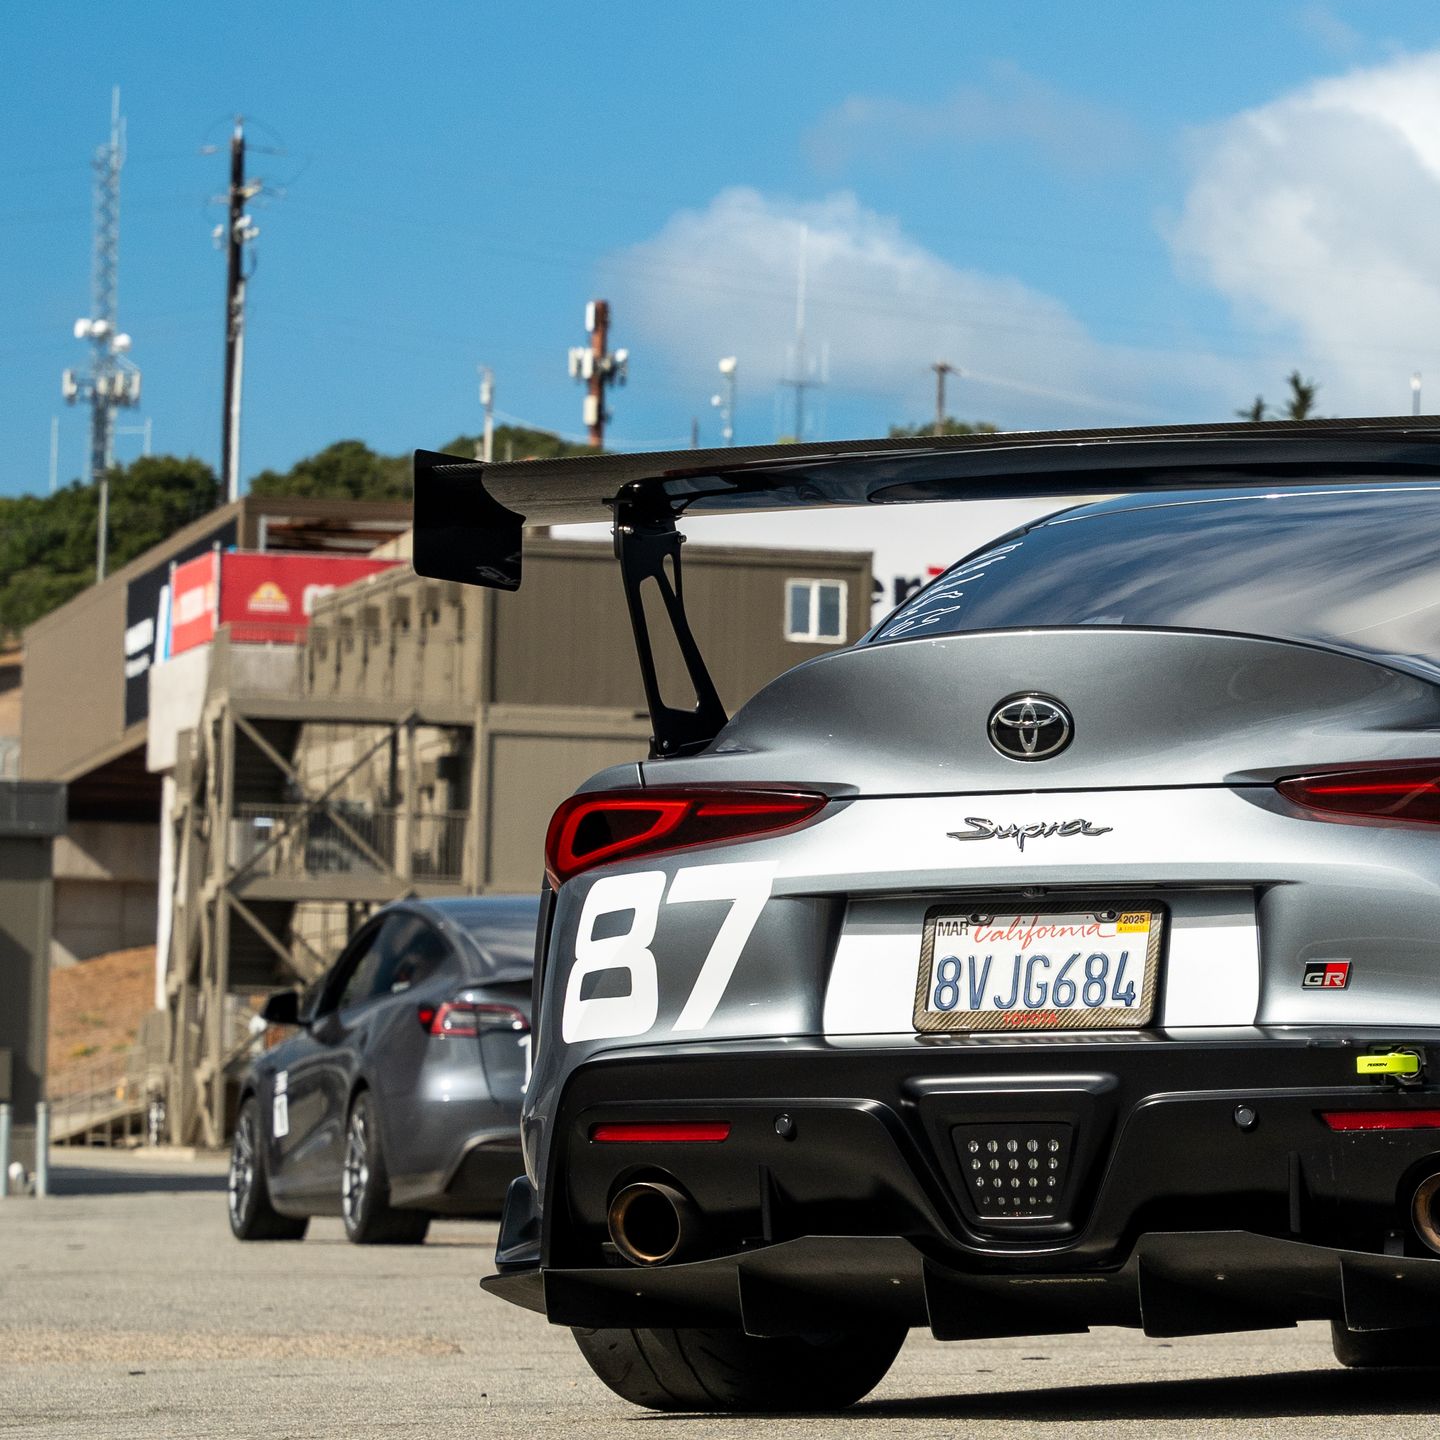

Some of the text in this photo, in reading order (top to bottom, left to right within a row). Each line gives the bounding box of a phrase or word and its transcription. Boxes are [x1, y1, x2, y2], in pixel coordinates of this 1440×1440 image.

[946, 817, 1113, 852] Supra
[937, 915, 1145, 950] MAR California 2025
[561, 860, 780, 1044] 87
[933, 951, 1136, 1011] 8VJG684
[1304, 972, 1344, 986] GR
[1003, 1013, 1058, 1025] TOYOTA
